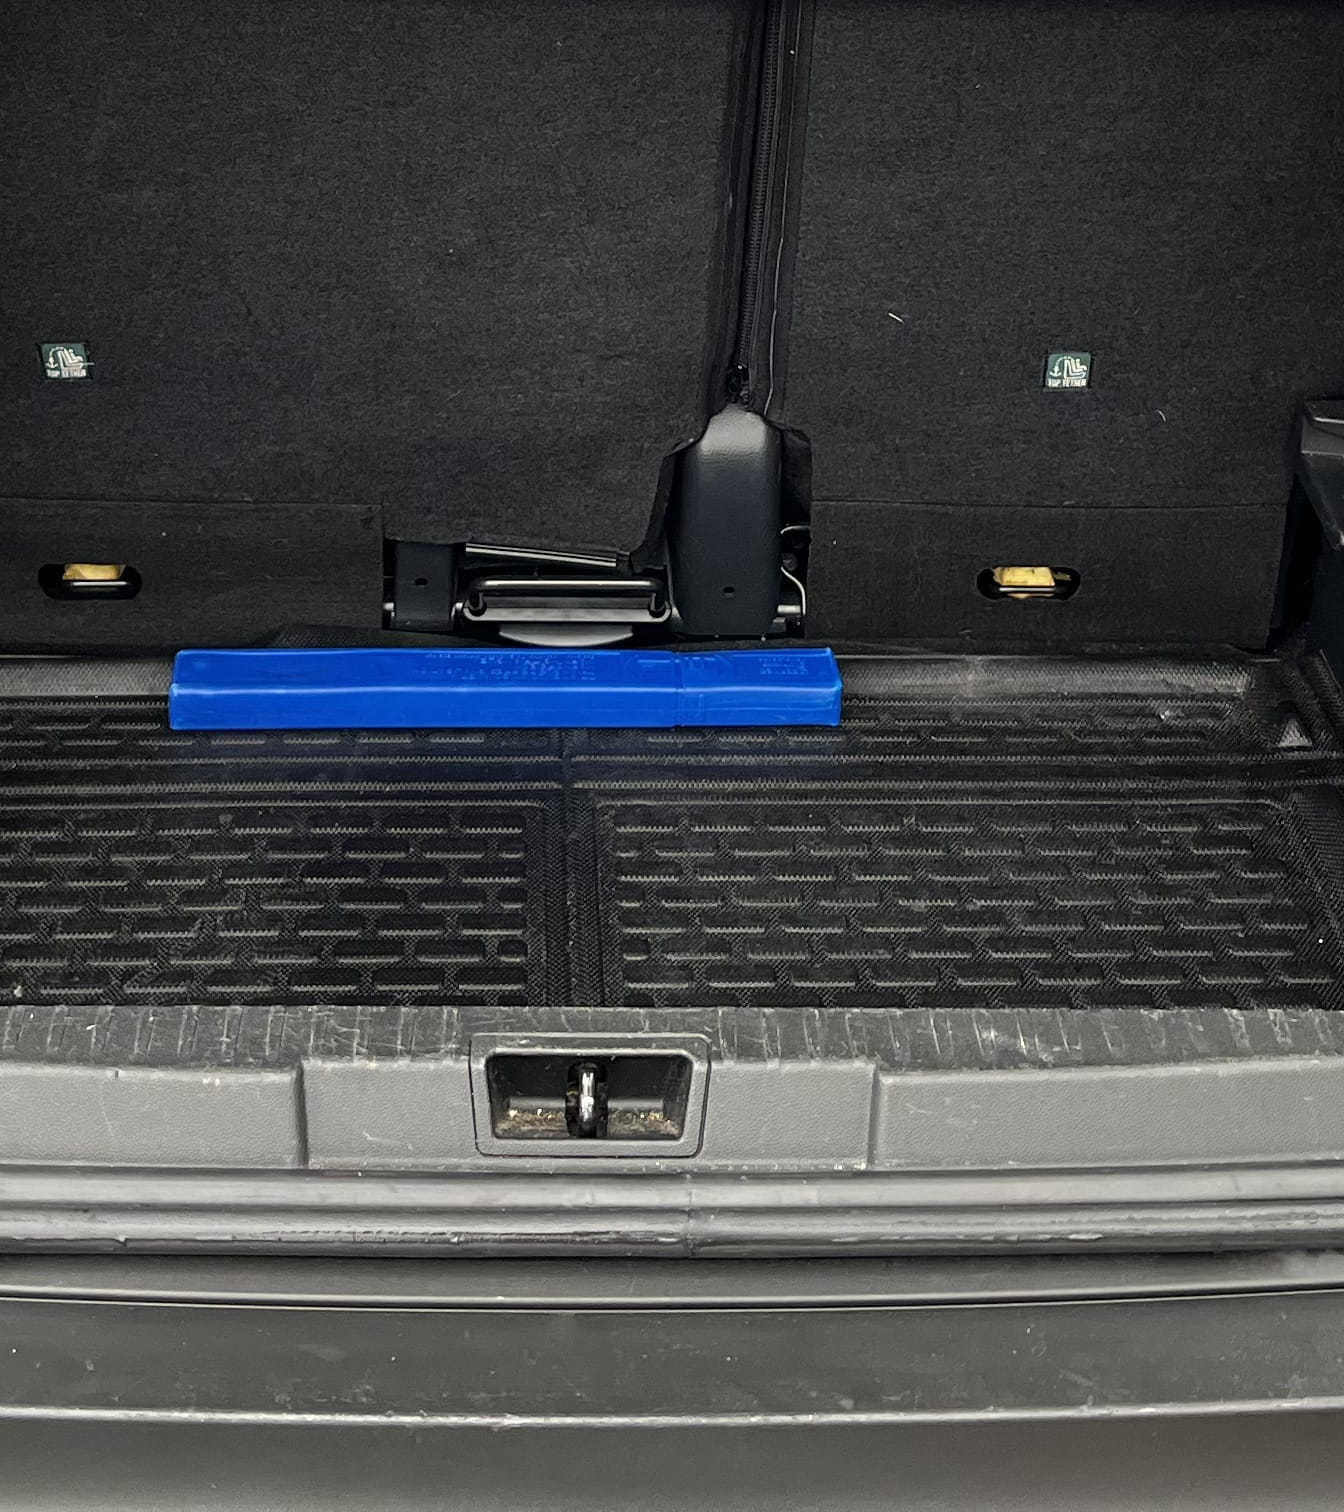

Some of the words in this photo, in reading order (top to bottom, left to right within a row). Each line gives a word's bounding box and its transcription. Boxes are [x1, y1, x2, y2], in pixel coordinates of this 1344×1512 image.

[46, 369, 60, 378] TOP
[61, 369, 86, 378] TETHER
[1048, 378, 1061, 388] TOP
[1062, 378, 1086, 388] TETHER
